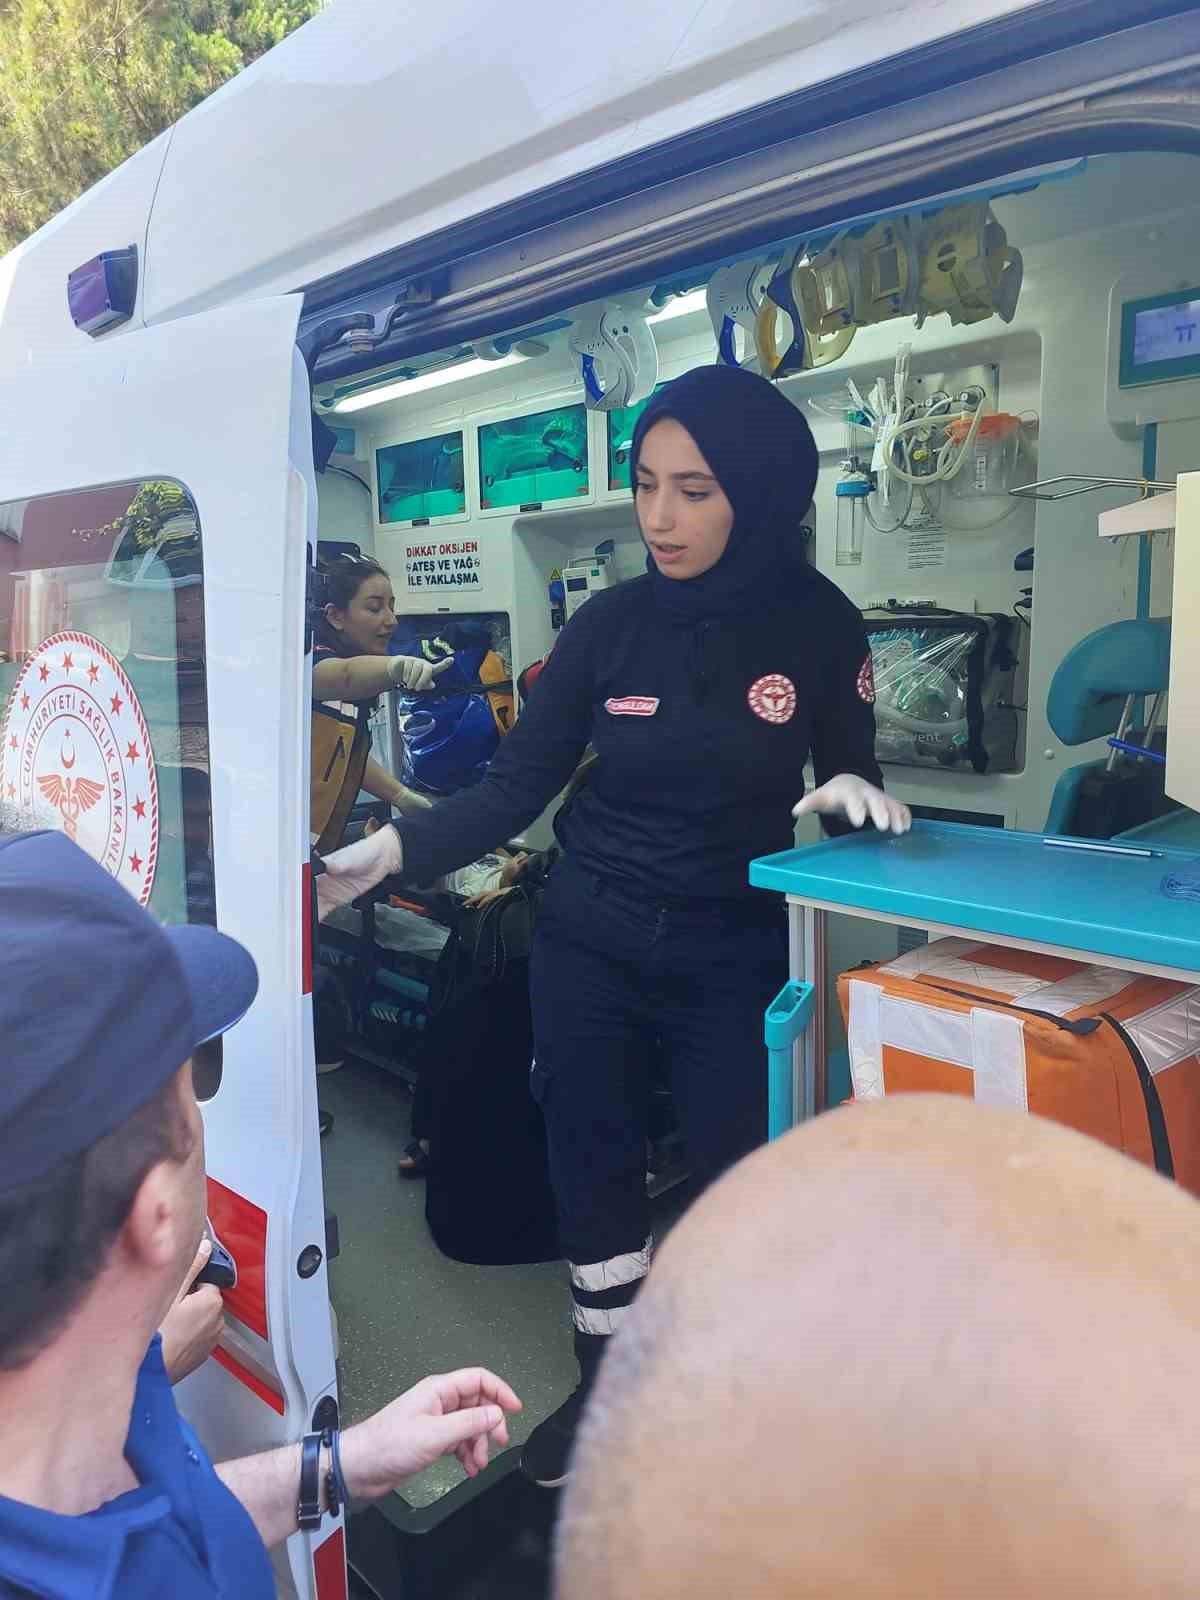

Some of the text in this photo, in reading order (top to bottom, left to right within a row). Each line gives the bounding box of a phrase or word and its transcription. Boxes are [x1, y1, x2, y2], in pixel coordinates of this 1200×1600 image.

[412, 556, 473, 572] ATEŞ VE YAĞ
[425, 572, 479, 586] YAKLAŞMA
[105, 771, 122, 873] BAKANLI
